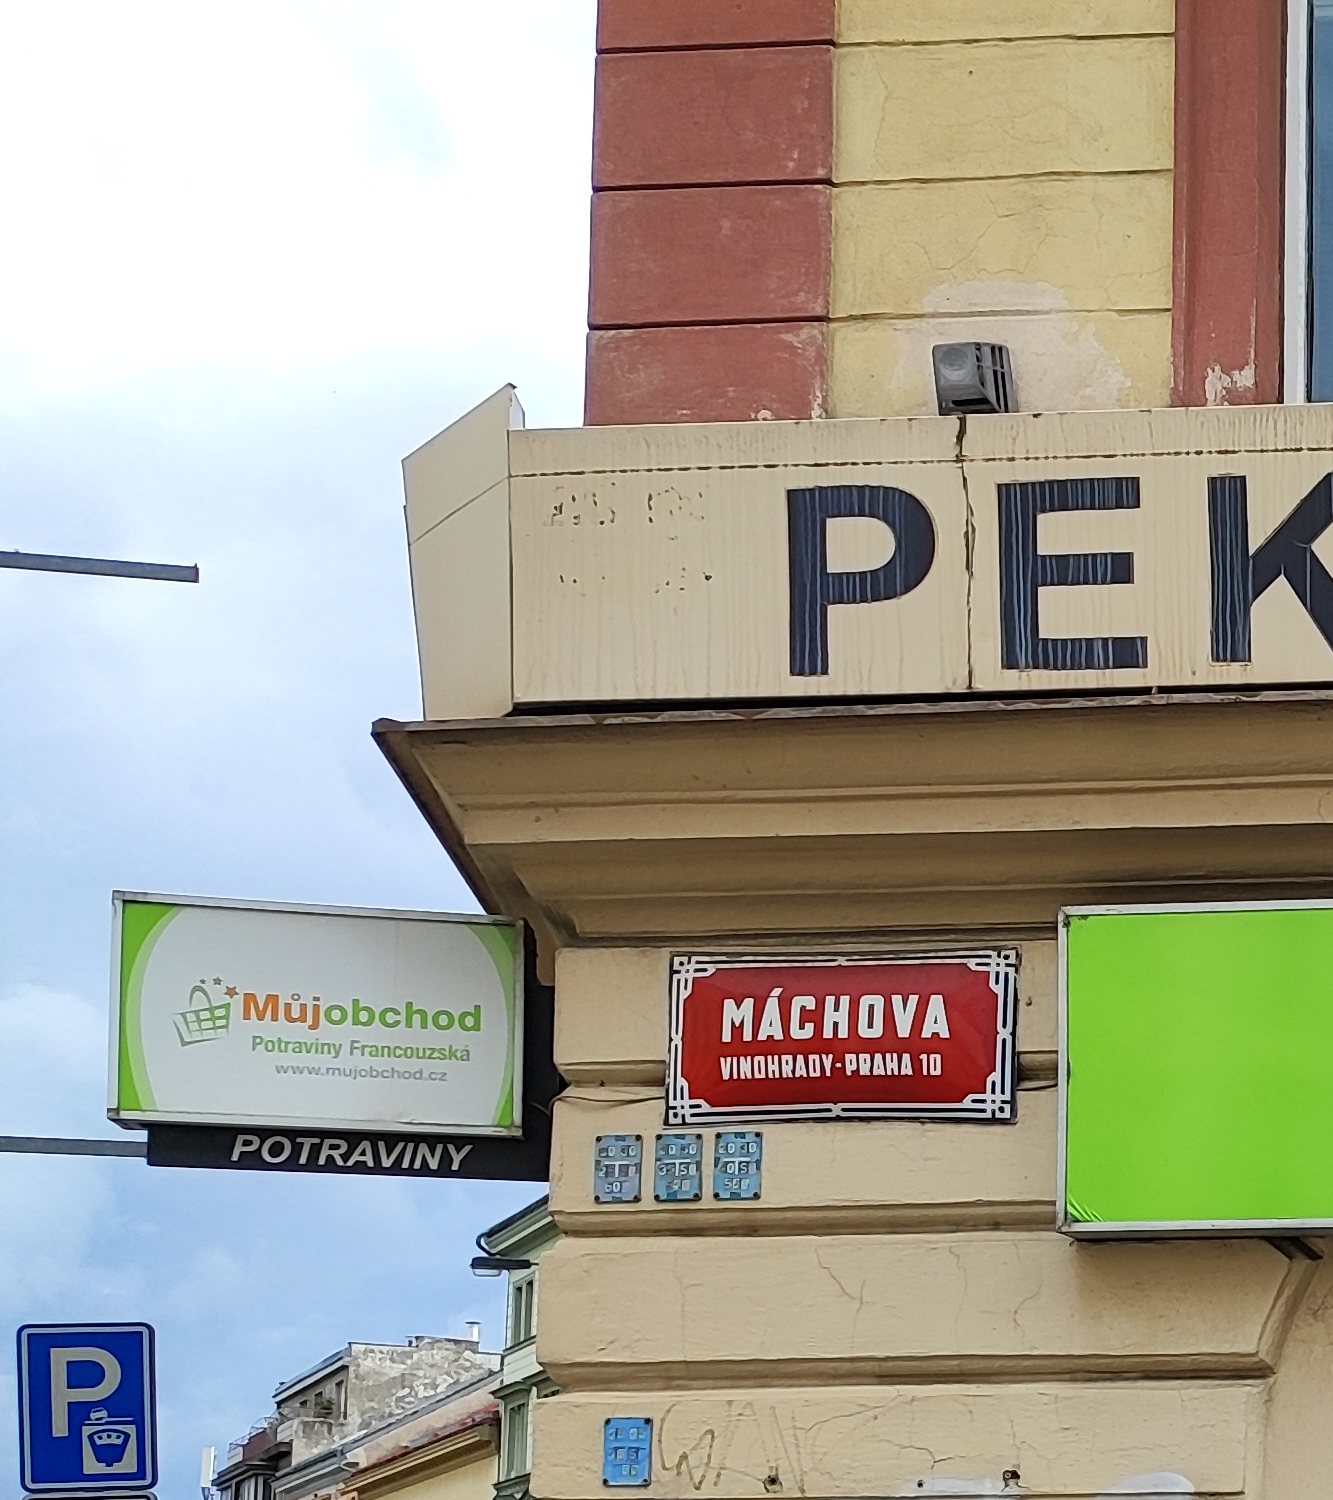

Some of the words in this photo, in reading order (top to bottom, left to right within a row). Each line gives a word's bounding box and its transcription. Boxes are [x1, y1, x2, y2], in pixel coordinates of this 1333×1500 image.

[241, 991, 482, 1033] Můjobchod
[721, 987, 950, 1043] MÁCHOVA
[251, 1034, 343, 1060] Potraviny
[350, 1038, 471, 1063] Francouzská
[919, 1053, 942, 1077] 10
[274, 1063, 448, 1082] www.mujobchod.cz
[230, 1134, 473, 1172] POTRAVINY
[50, 1347, 121, 1437] P
